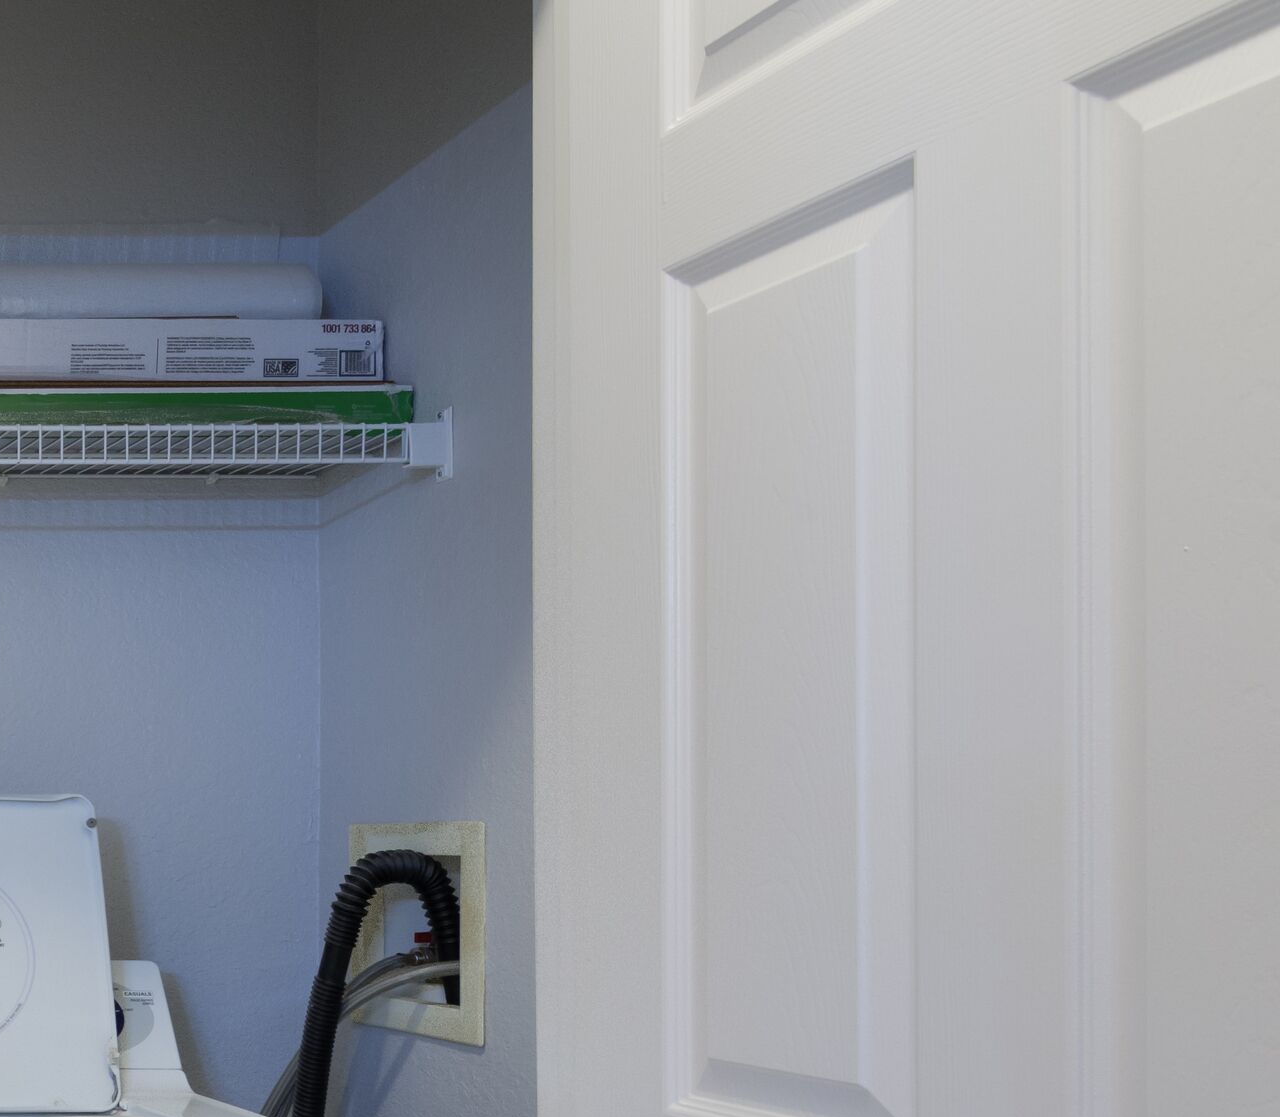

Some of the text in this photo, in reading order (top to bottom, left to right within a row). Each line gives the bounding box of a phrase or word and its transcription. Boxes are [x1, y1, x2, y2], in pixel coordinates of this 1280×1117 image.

[321, 324, 376, 334] 1001 733 864
